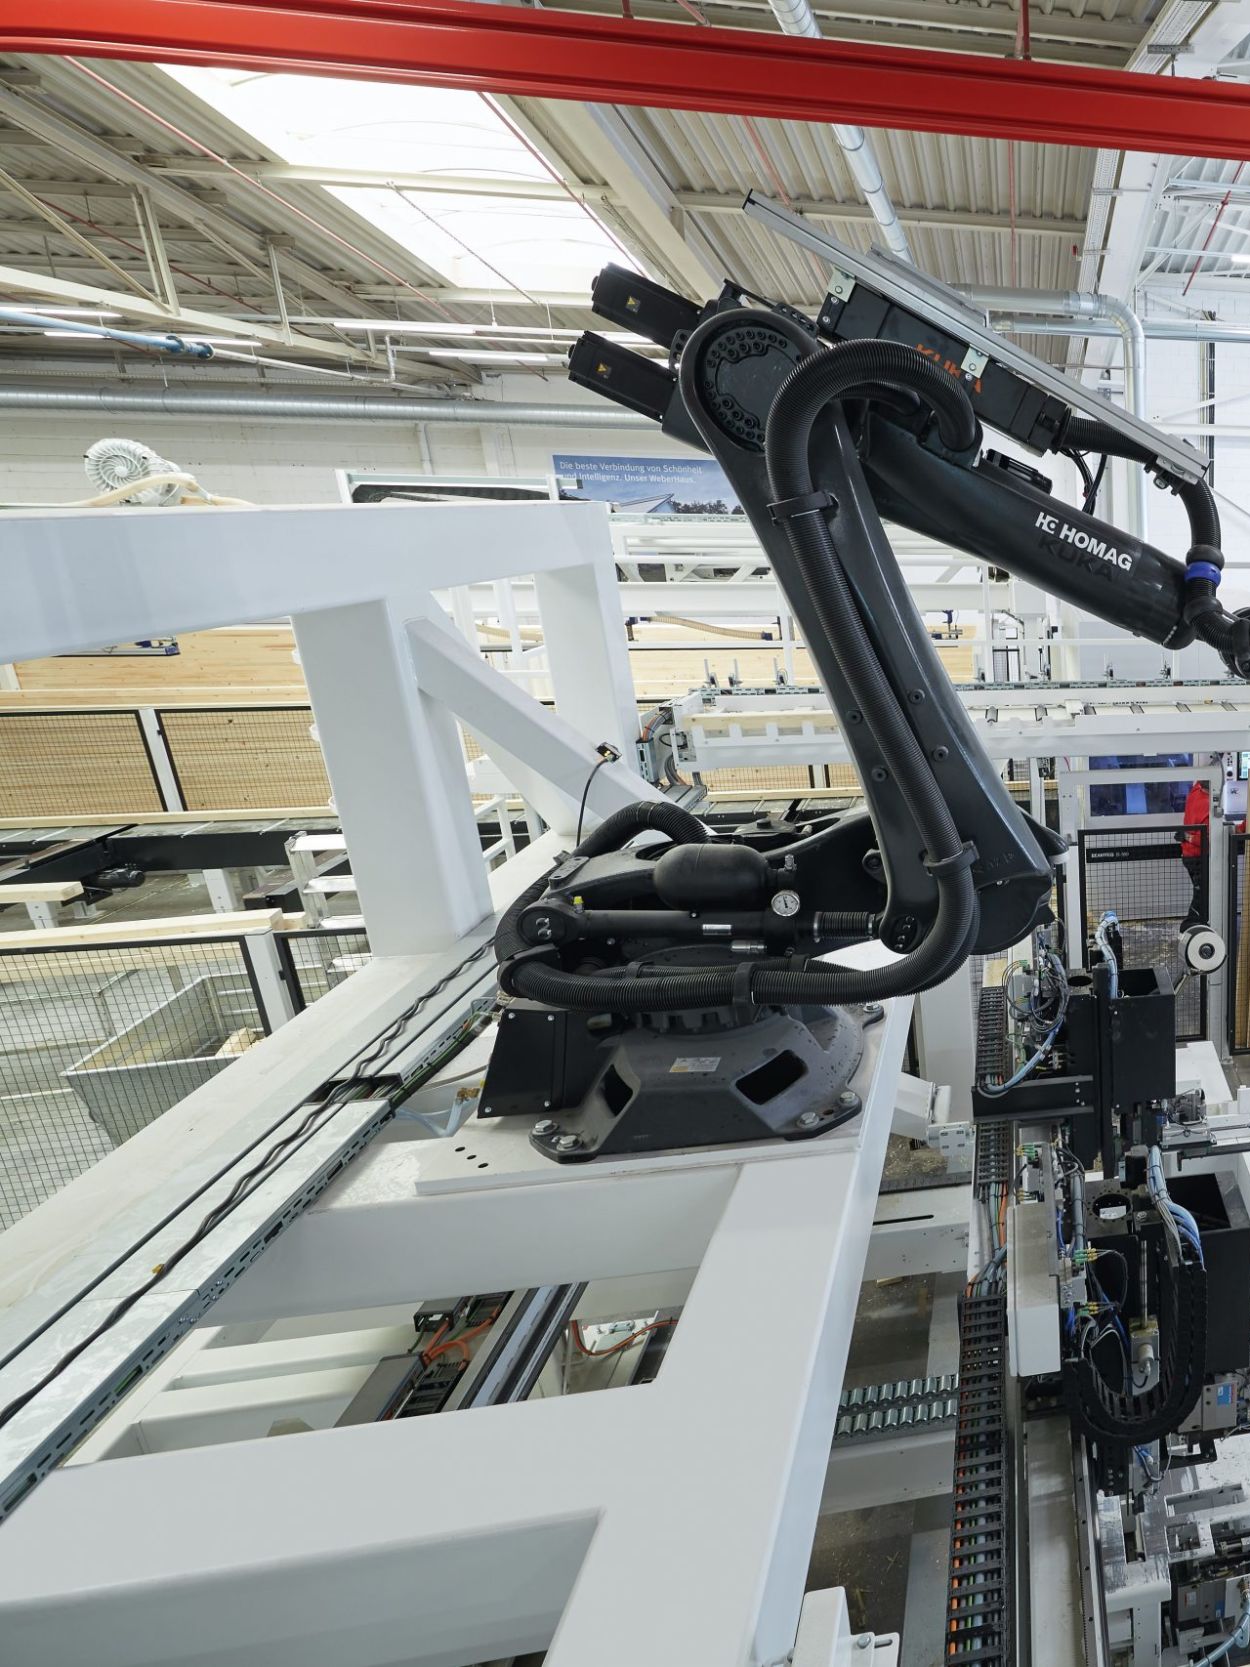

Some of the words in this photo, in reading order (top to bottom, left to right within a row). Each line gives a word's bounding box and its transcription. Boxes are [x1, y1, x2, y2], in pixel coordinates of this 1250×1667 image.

[560, 462, 574, 470] Die
[575, 462, 598, 471] beste
[600, 463, 645, 473] Verbindung
[663, 464, 703, 474] Schönheit
[579, 473, 621, 482] Intelligenz.
[624, 474, 647, 482] Unser
[1059, 523, 1133, 571] HOMAG
